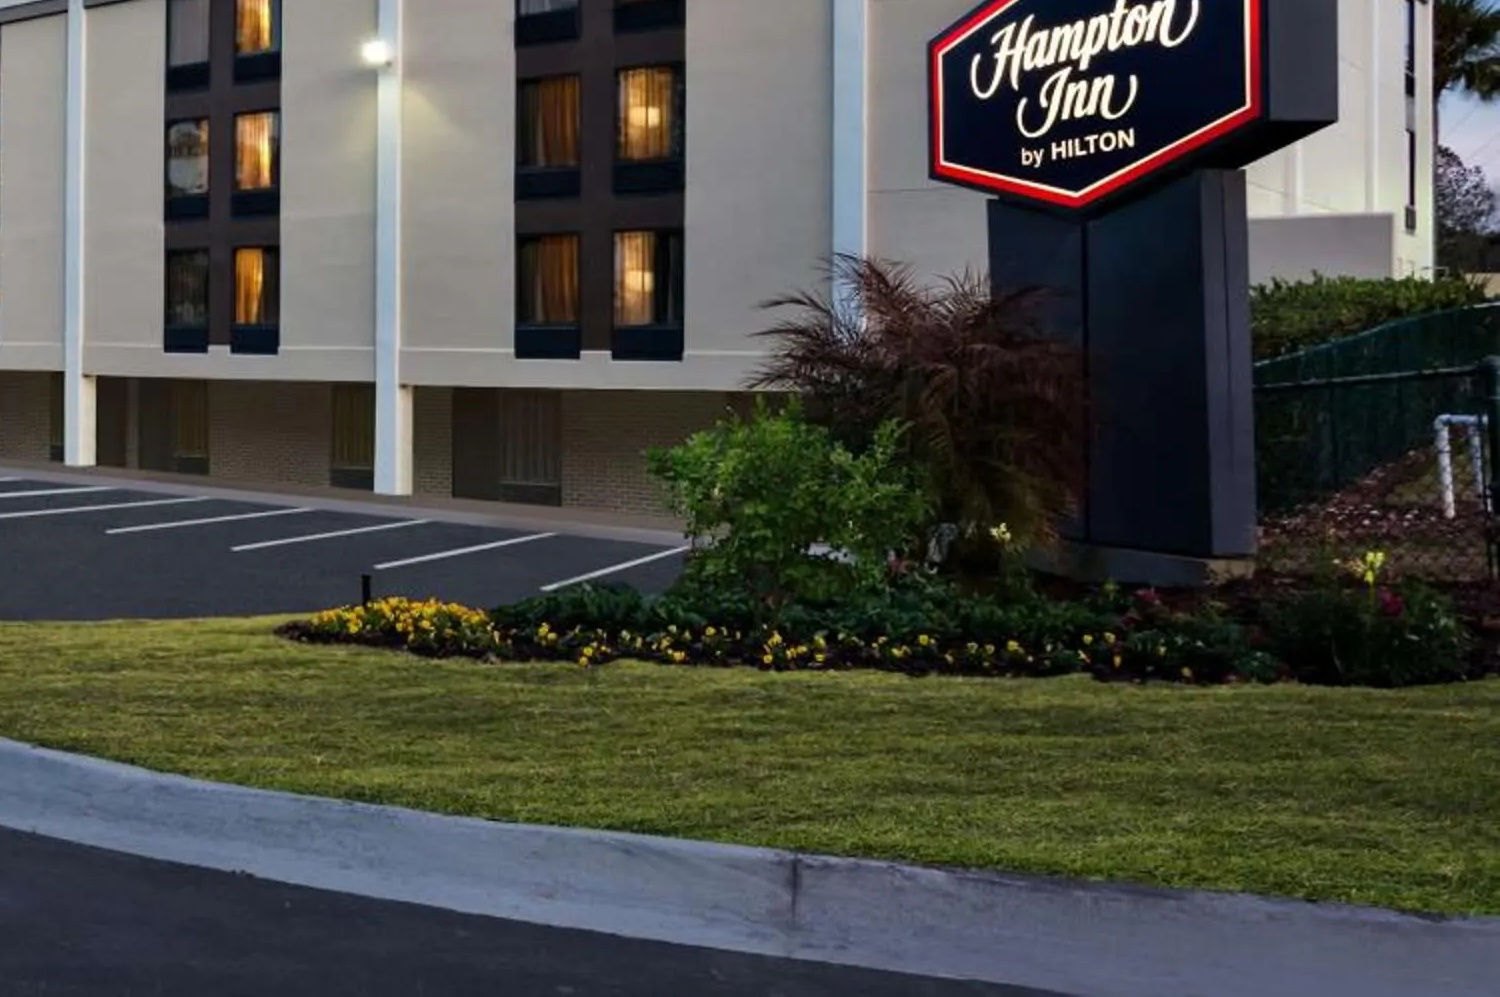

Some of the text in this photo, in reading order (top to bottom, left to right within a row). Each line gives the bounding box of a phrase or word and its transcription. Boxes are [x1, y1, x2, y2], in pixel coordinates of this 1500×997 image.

[1016, 67, 1139, 139] Inn
[1021, 128, 1136, 168] by HILTON
